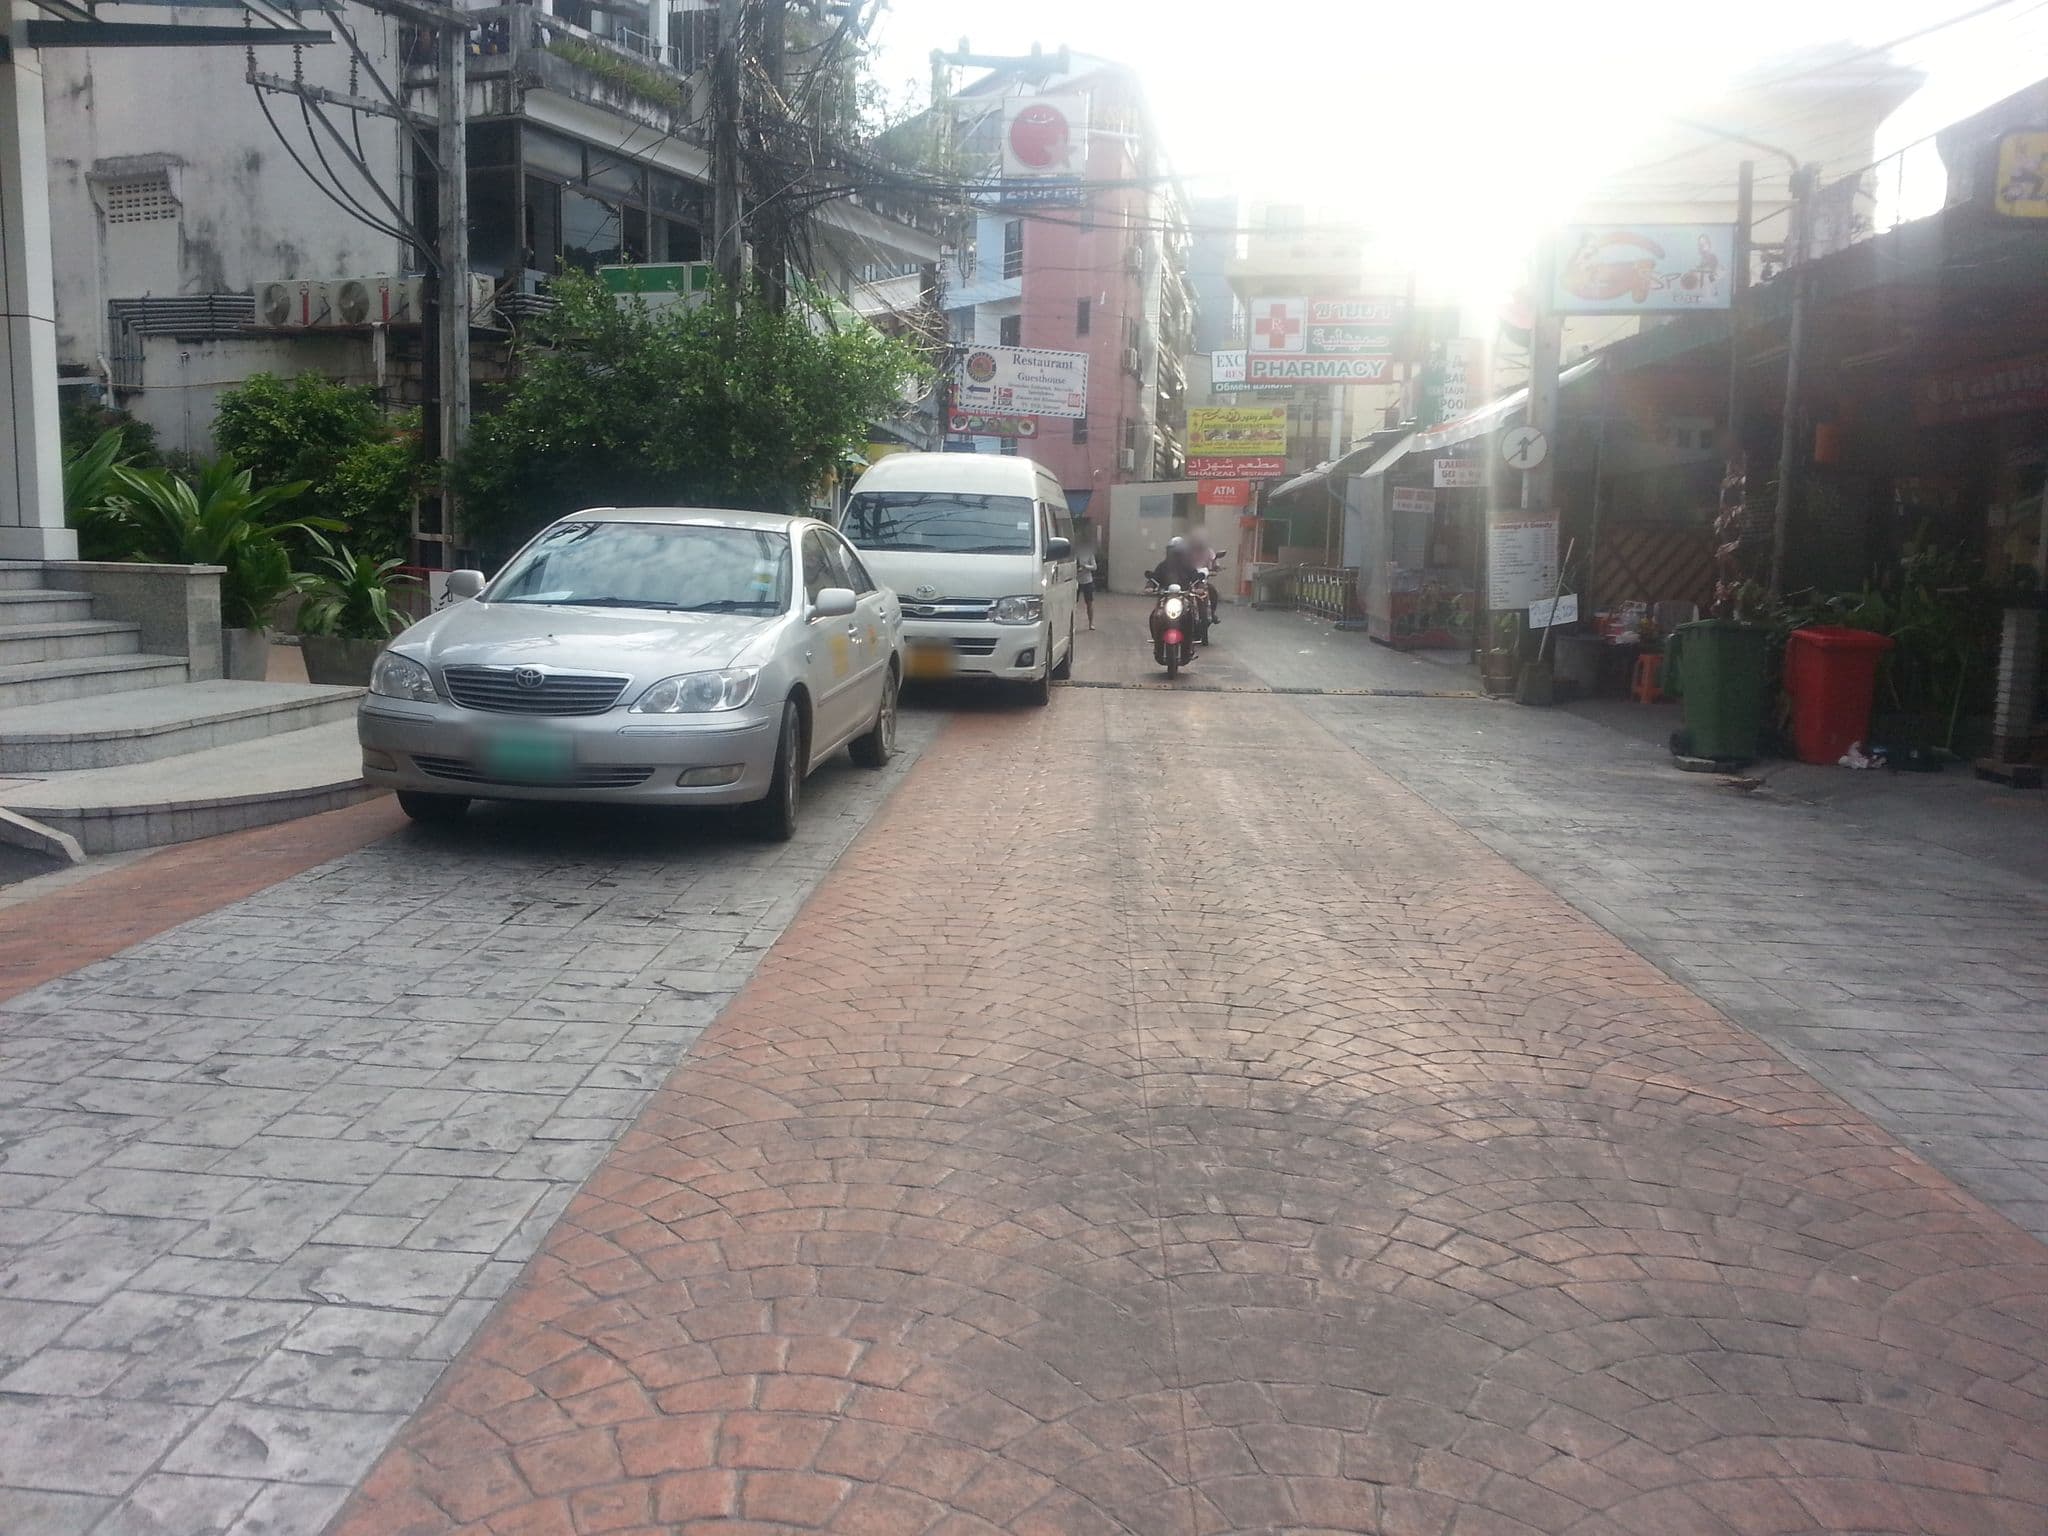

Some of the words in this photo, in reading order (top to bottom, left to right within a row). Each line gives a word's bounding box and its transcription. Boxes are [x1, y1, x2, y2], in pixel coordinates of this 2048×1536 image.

[1012, 353, 1074, 369] Restaurant
[1252, 360, 1385, 377] PHARMACY
[1017, 372, 1066, 384] Guesthouse
[1212, 485, 1235, 495] ATM
